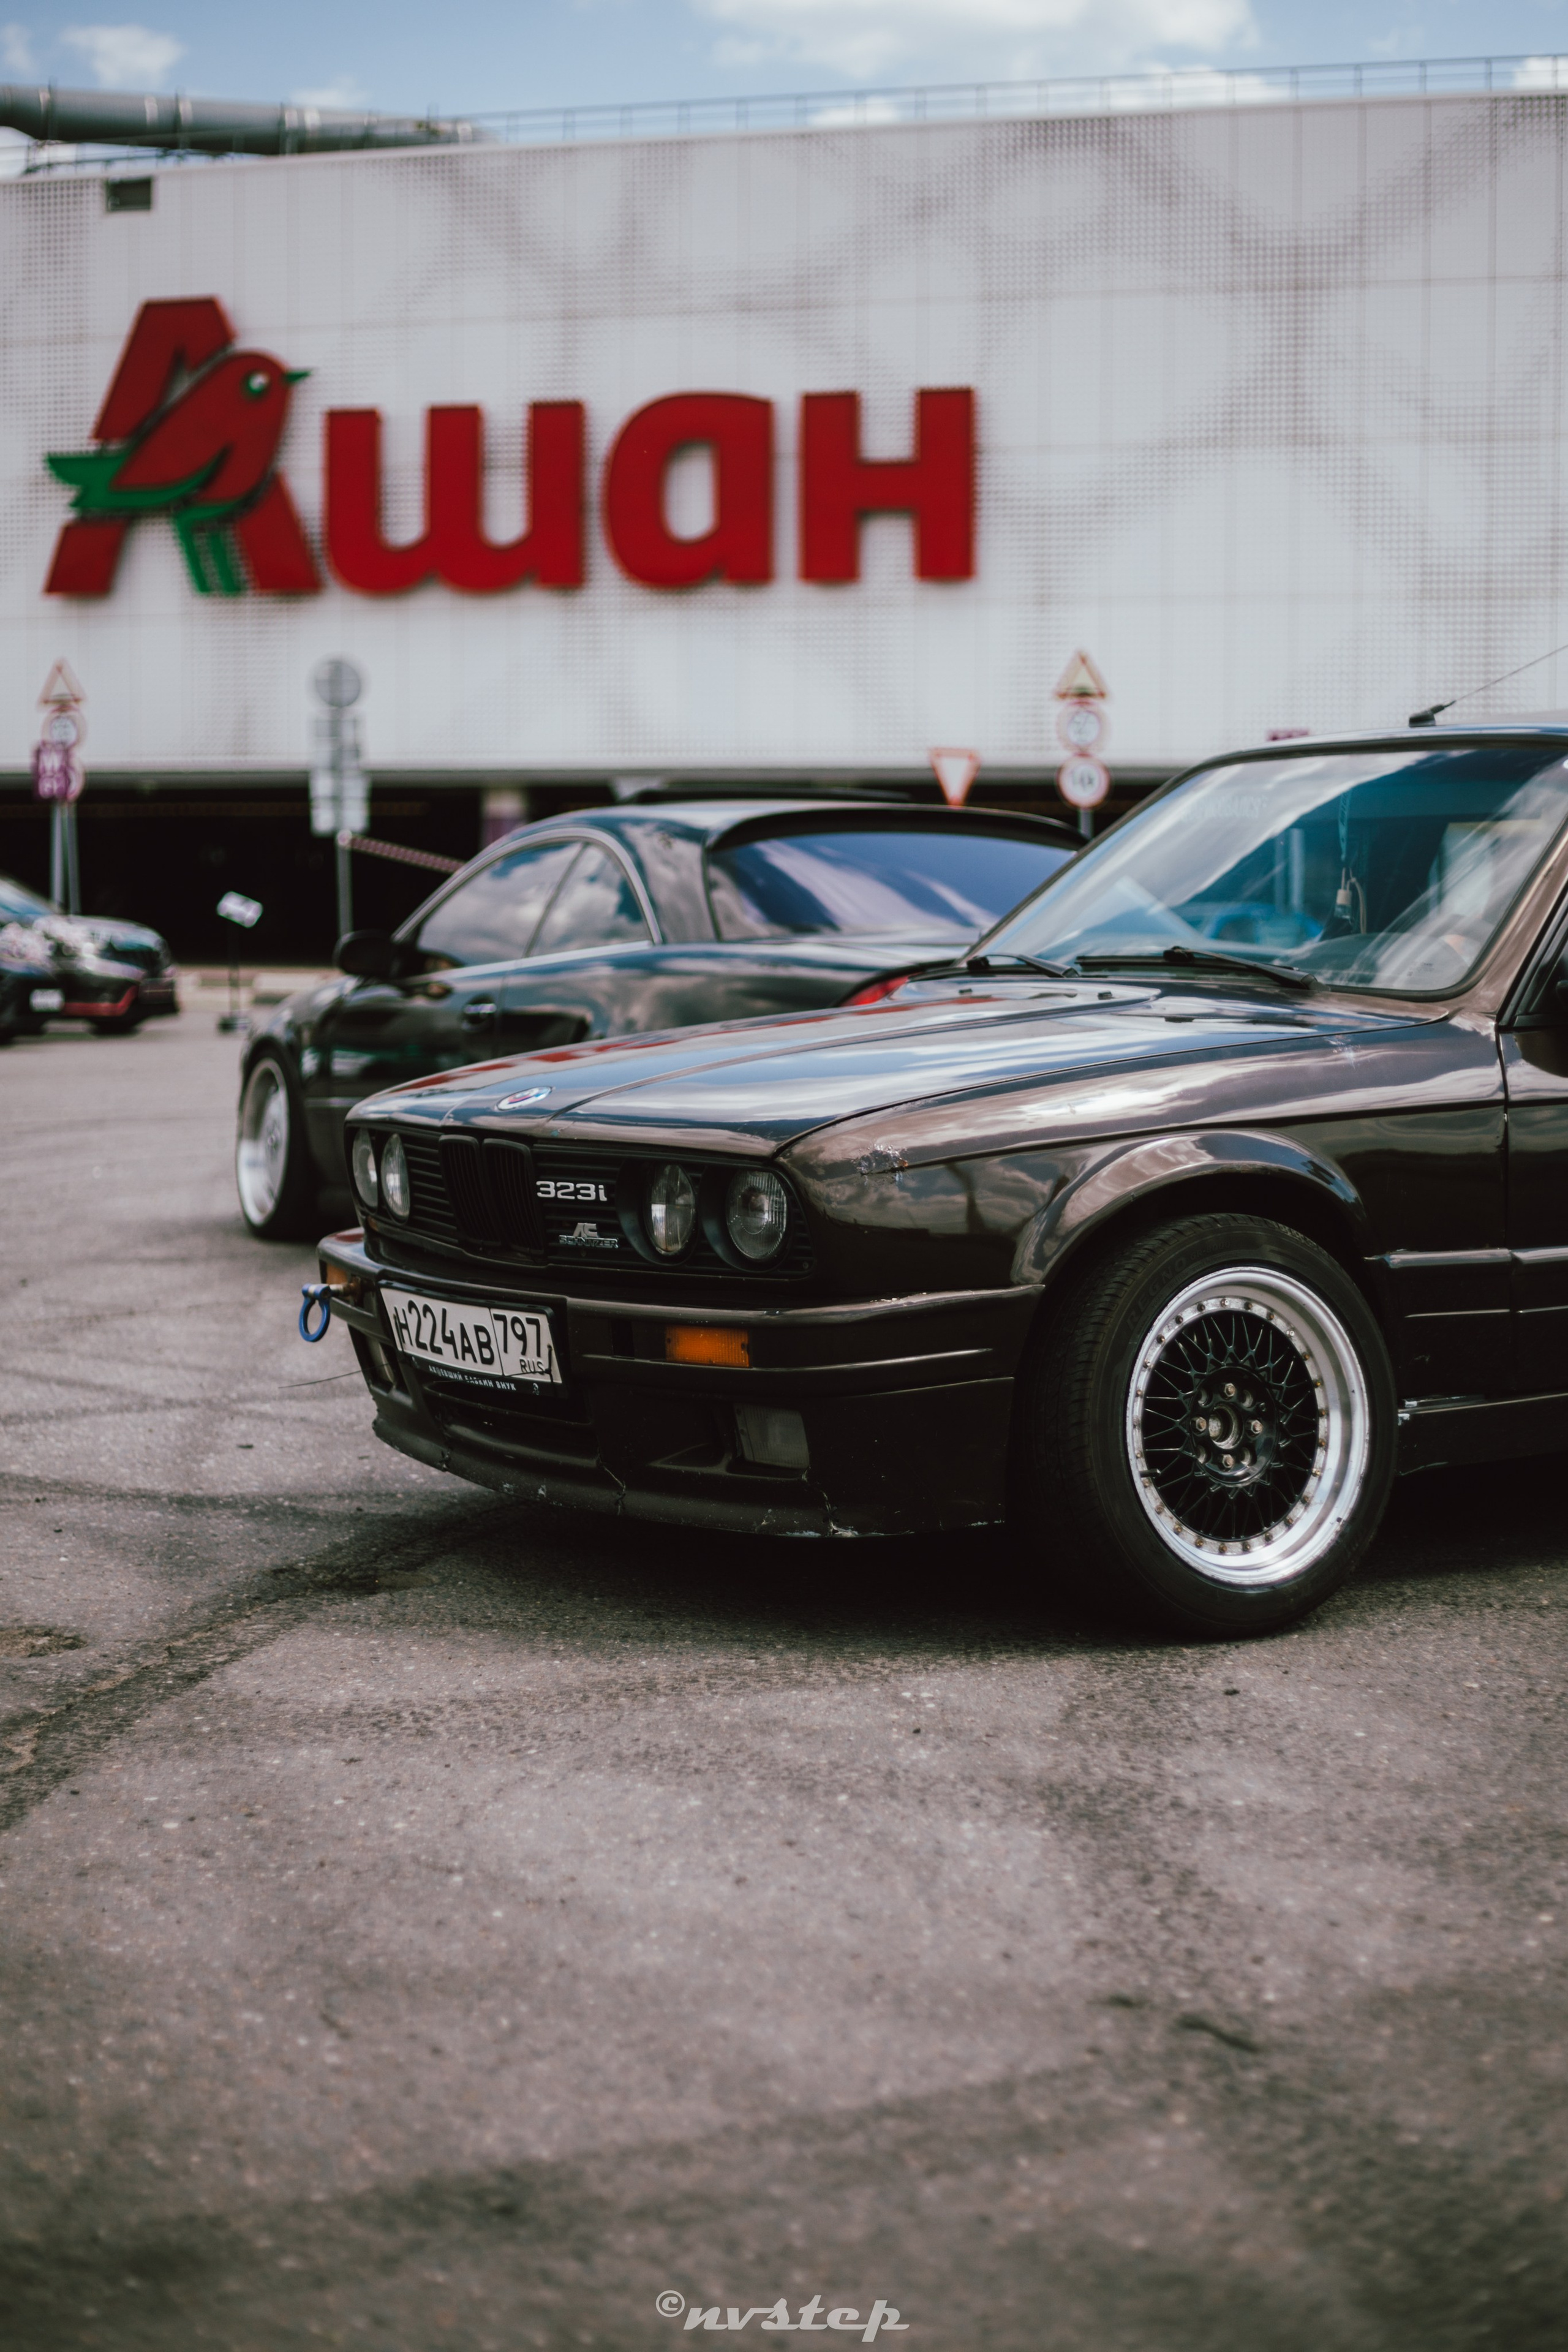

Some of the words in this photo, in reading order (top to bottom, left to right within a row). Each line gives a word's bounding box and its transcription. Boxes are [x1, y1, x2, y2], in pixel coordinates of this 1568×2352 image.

[536, 1181, 608, 1201] 323i
[1126, 1256, 1187, 1332] REGNO
[519, 1359, 545, 1374] RUS
[496, 1381, 516, 1390] ВНУК
